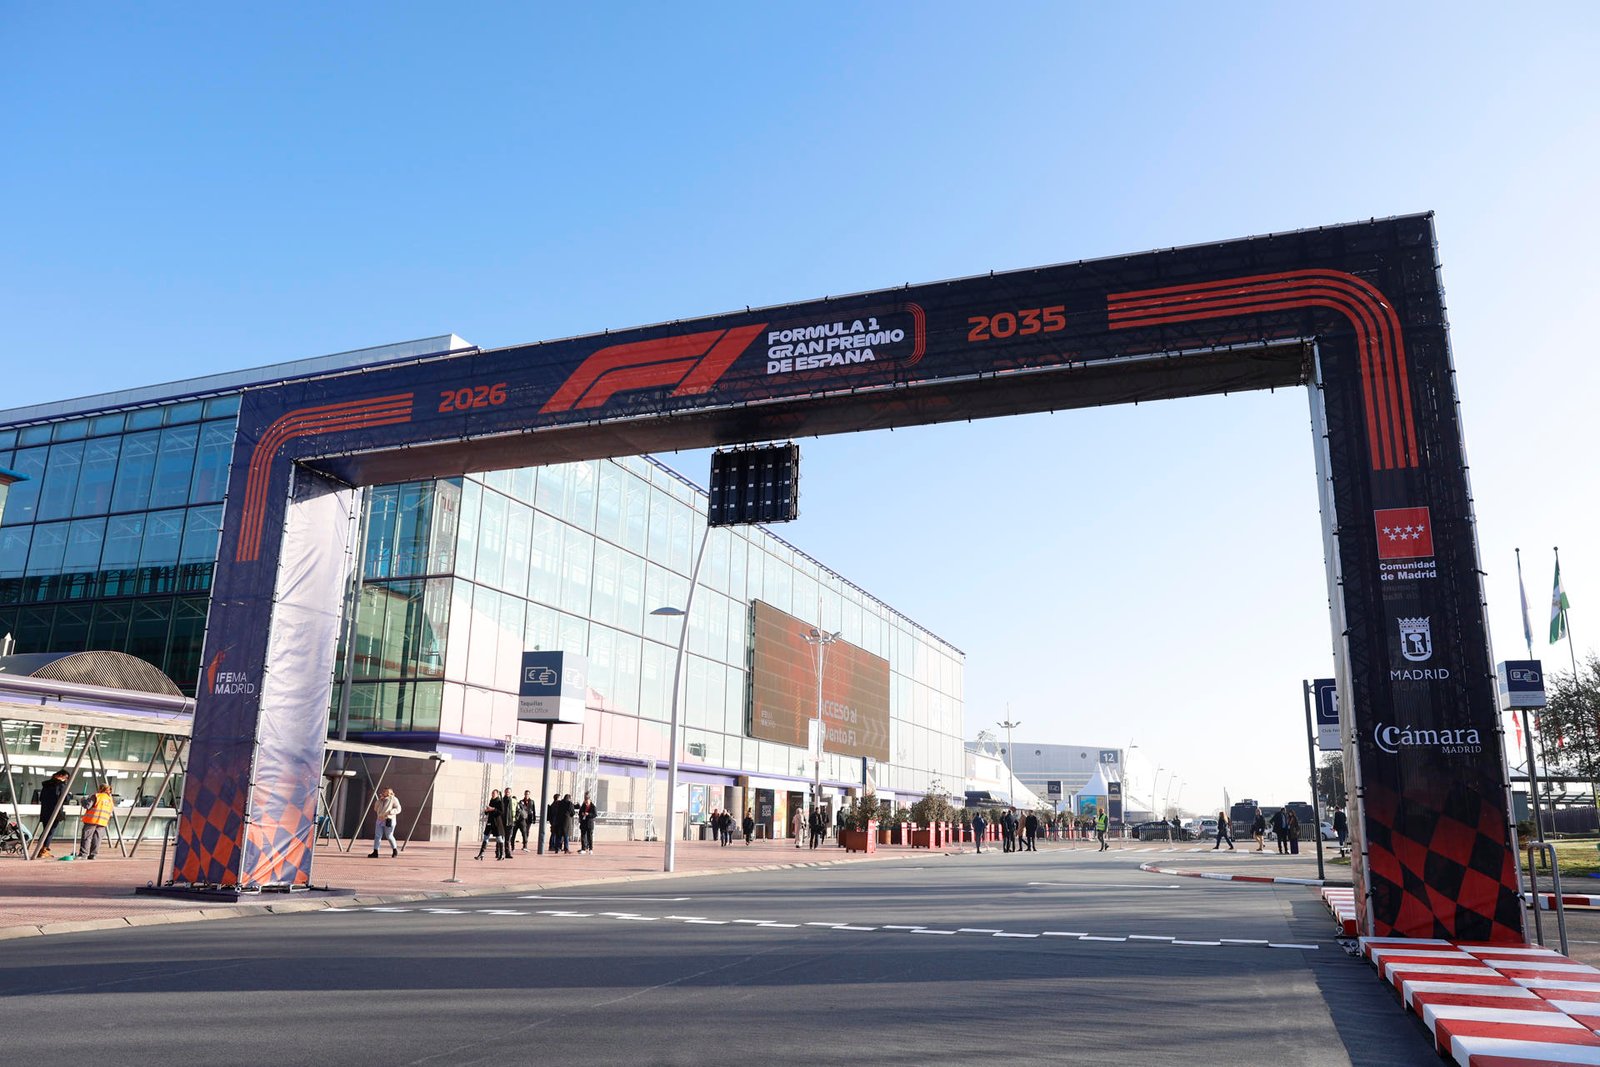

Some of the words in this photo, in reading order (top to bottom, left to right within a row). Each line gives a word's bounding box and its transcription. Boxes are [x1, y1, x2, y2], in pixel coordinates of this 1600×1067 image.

[967, 305, 1066, 342] 2035
[768, 319, 865, 345] FORMULA
[868, 317, 880, 331] 1
[768, 341, 824, 359] GRAN
[826, 329, 905, 352] PREMIO
[767, 358, 793, 375] DE
[438, 382, 507, 413] 2026
[1380, 560, 1436, 571] Comunidad
[1380, 572, 1395, 581] de
[1397, 569, 1437, 580] Madrid
[216, 671, 247, 683] IFEMA
[1390, 668, 1450, 681] MADRID
[214, 682, 255, 695] MADRID
[520, 700, 543, 708] Taquillas
[825, 727, 848, 745] vento
[1382, 725, 1481, 746] Cámara
[1441, 745, 1482, 754] MADRID
[1103, 752, 1115, 762] 12
